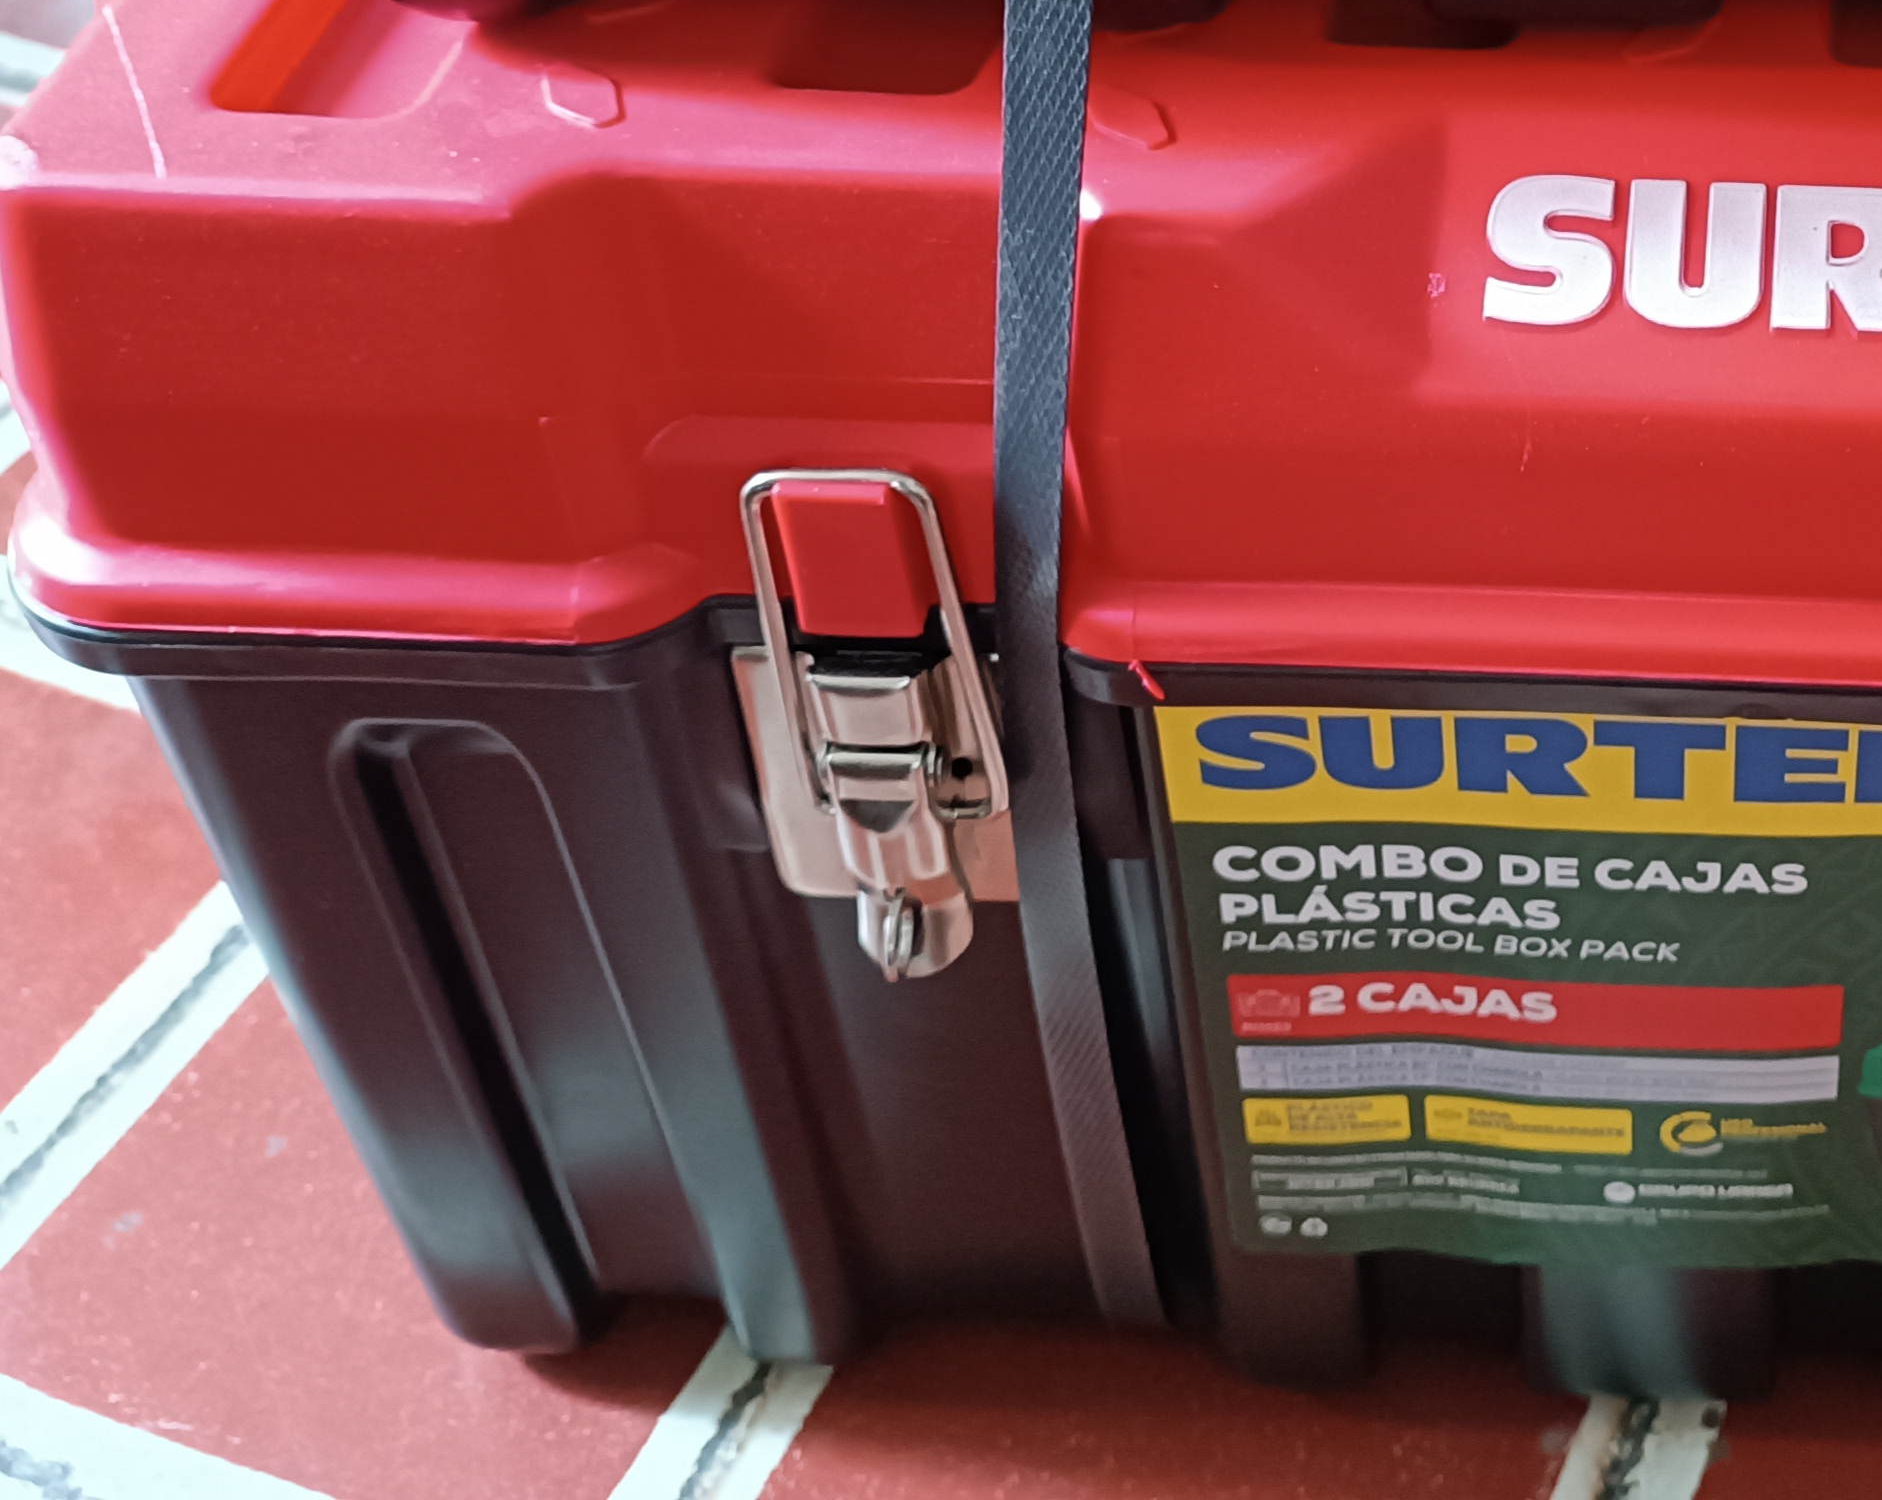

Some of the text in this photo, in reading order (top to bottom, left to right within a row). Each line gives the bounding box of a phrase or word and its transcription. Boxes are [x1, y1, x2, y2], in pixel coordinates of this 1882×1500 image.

[1212, 844, 1809, 894] COMBO DE CAJAS
[1218, 884, 1561, 930] PLÁSTICAS
[1222, 928, 1681, 963] PLASTIC TOOL BOX PACK
[1308, 982, 1558, 1023] 2 CAJAS
